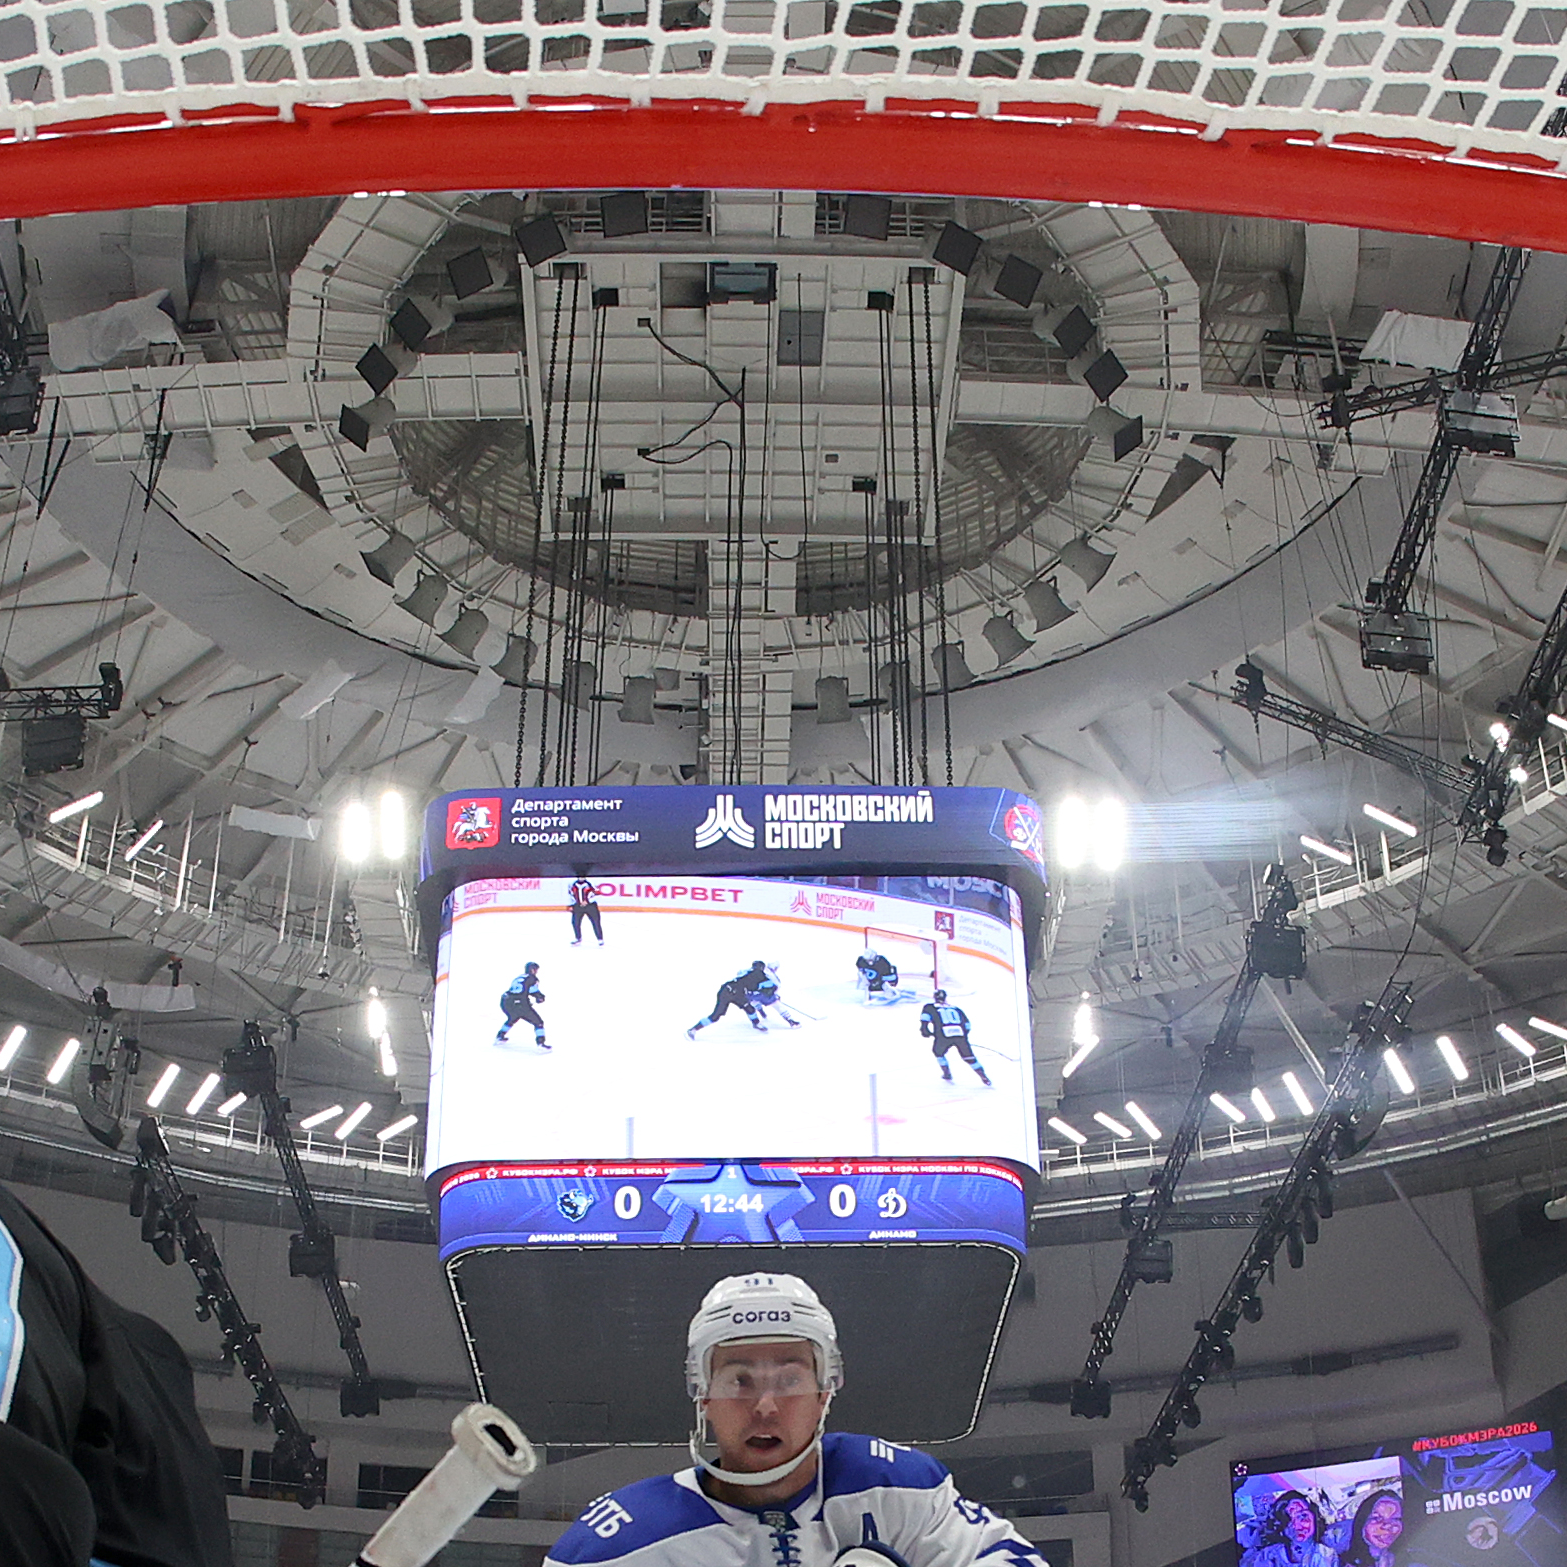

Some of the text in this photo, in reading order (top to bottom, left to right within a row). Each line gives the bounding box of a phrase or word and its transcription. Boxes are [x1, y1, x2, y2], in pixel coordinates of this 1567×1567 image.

[511, 799, 623, 814] Департамент
[764, 791, 934, 823] МОСКОВСКИЙ
[511, 816, 569, 830] спорта
[511, 830, 639, 846] города Москвы
[764, 823, 845, 849] СПОРТ
[597, 882, 744, 904] OLIMPBET
[816, 892, 875, 913] МОСКОВСКИЙ
[815, 908, 845, 921] СПОРТ
[728, 1168, 737, 1179] 1
[614, 1186, 642, 1220] 0
[700, 1194, 764, 1214] 12:44
[829, 1184, 857, 1217] 0
[528, 1232, 618, 1242] ДИНАМО-МИНСК
[868, 1230, 918, 1239] ДИНАМО
[732, 1310, 791, 1325] согаз
[1442, 1484, 1533, 1513] Moscow
